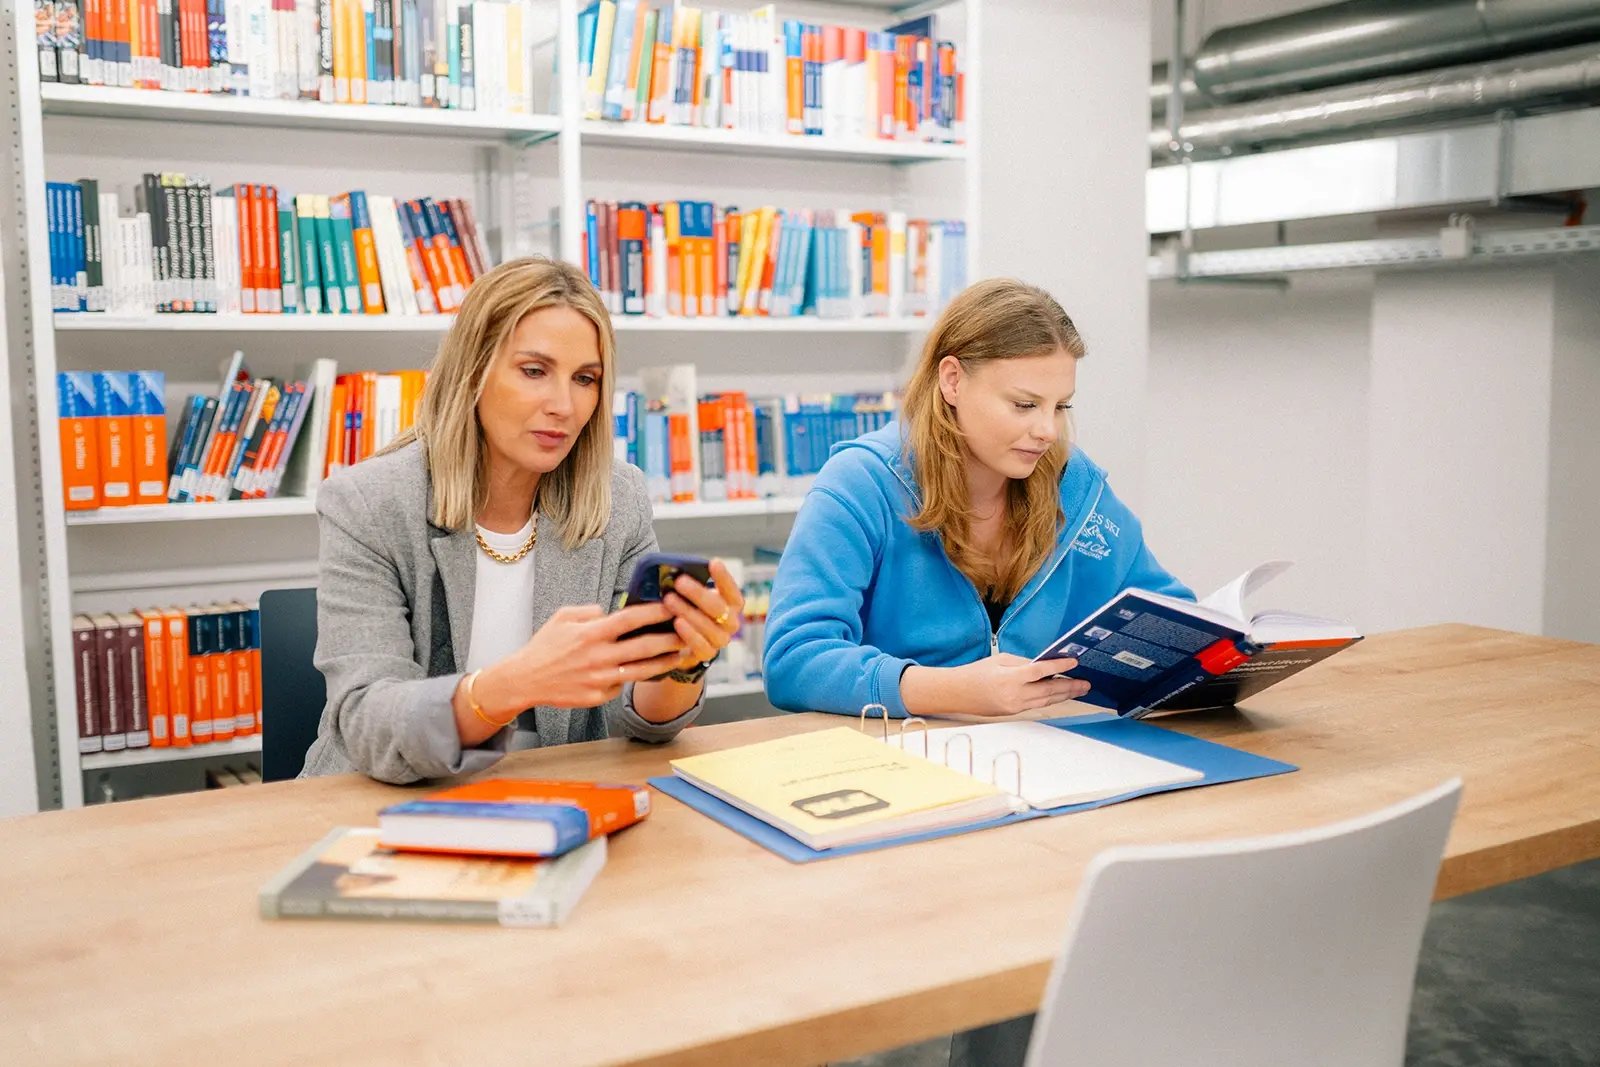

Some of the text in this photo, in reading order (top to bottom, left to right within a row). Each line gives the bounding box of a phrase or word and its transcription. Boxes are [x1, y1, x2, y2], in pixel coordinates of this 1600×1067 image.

[1089, 512, 1120, 537] ES SKI
[1090, 543, 1112, 557] Club
